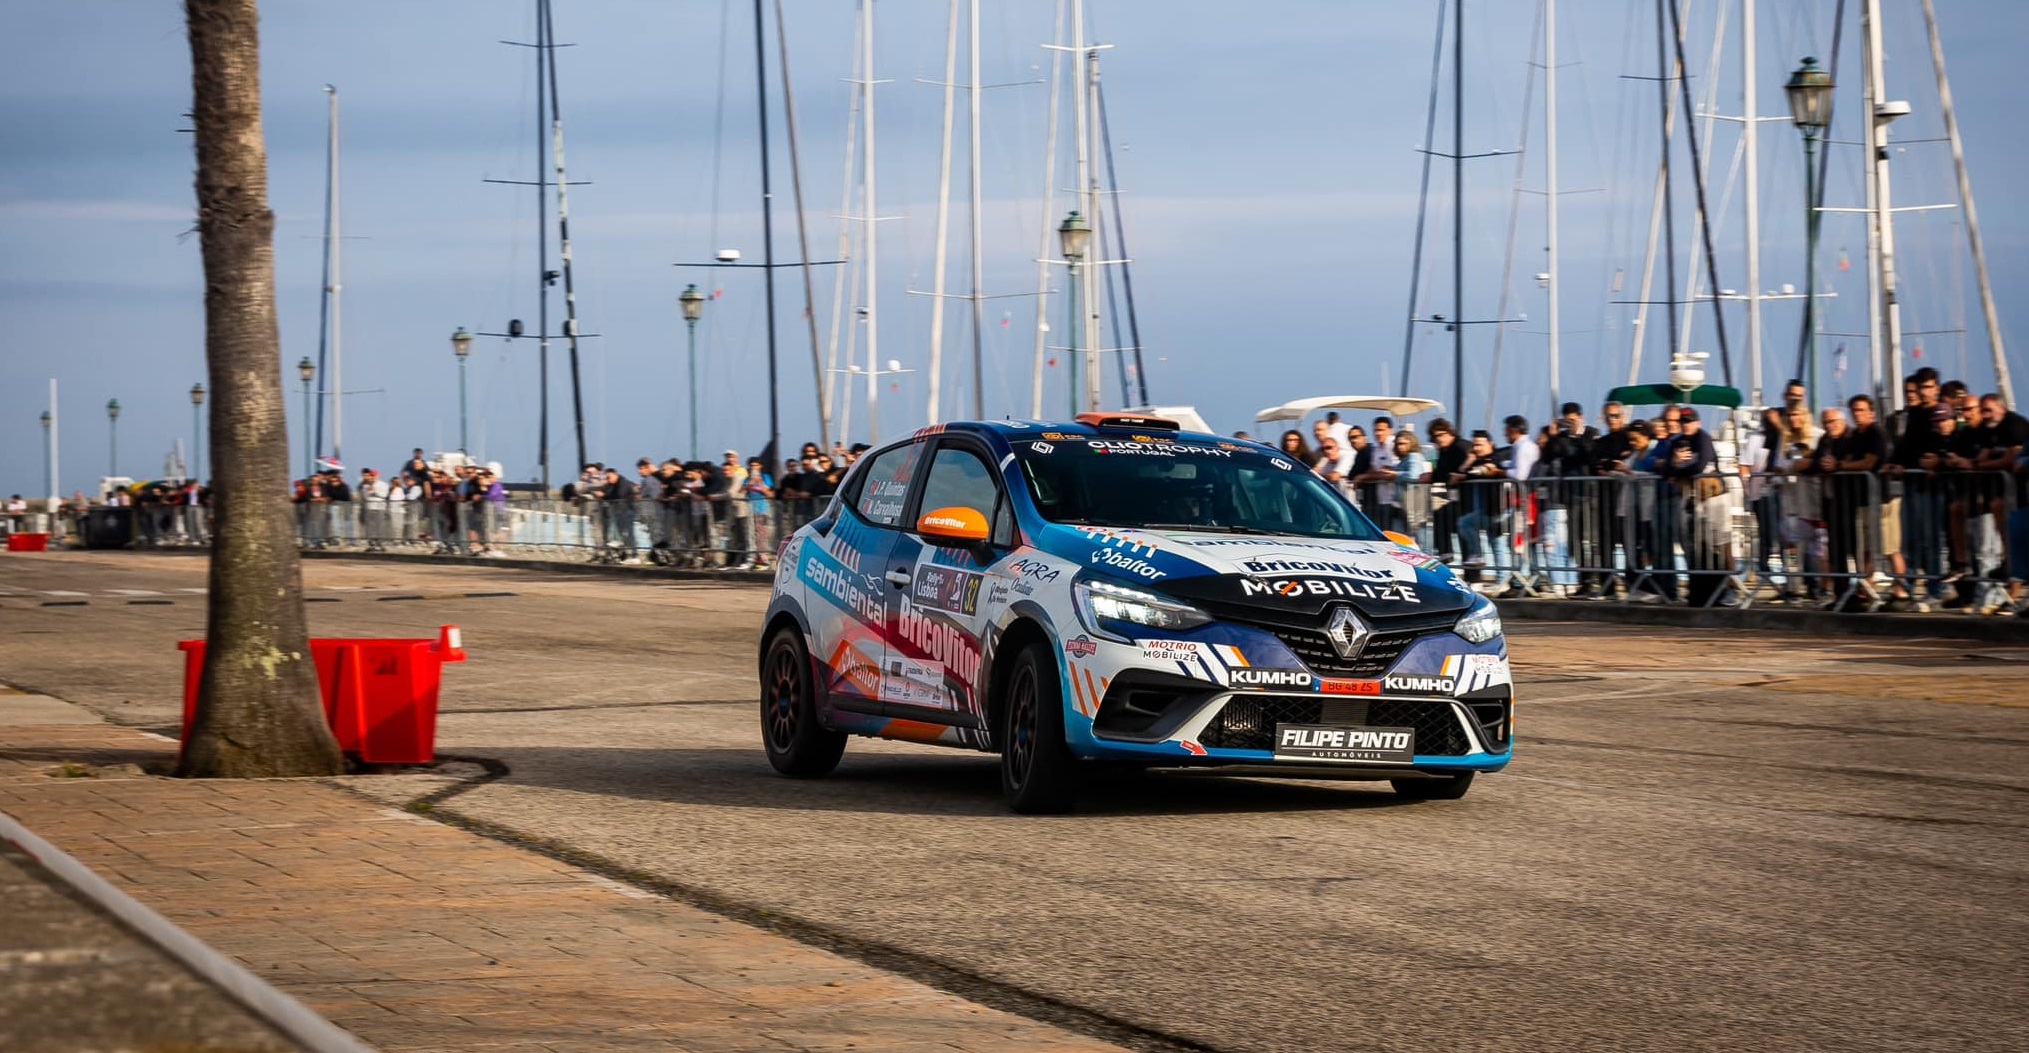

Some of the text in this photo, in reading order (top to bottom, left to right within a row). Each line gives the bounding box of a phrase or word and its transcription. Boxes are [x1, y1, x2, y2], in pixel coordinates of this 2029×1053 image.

[1108, 449, 1175, 457] PORTUGAL
[1010, 559, 1060, 583] AGRA
[1106, 552, 1167, 580] baltor
[1244, 560, 1394, 579] BricoVitor
[805, 556, 888, 629] sambiental
[917, 581, 938, 600] Lisboa
[964, 578, 979, 612] 32
[1240, 579, 1421, 604] MOBILIZE
[899, 593, 981, 690] BricoVitor
[1147, 641, 1198, 652] MOTRIO
[1231, 670, 1312, 686] KUMHO
[1384, 675, 1455, 692] KUMHO
[1281, 729, 1411, 750] FILIPE PINTO
